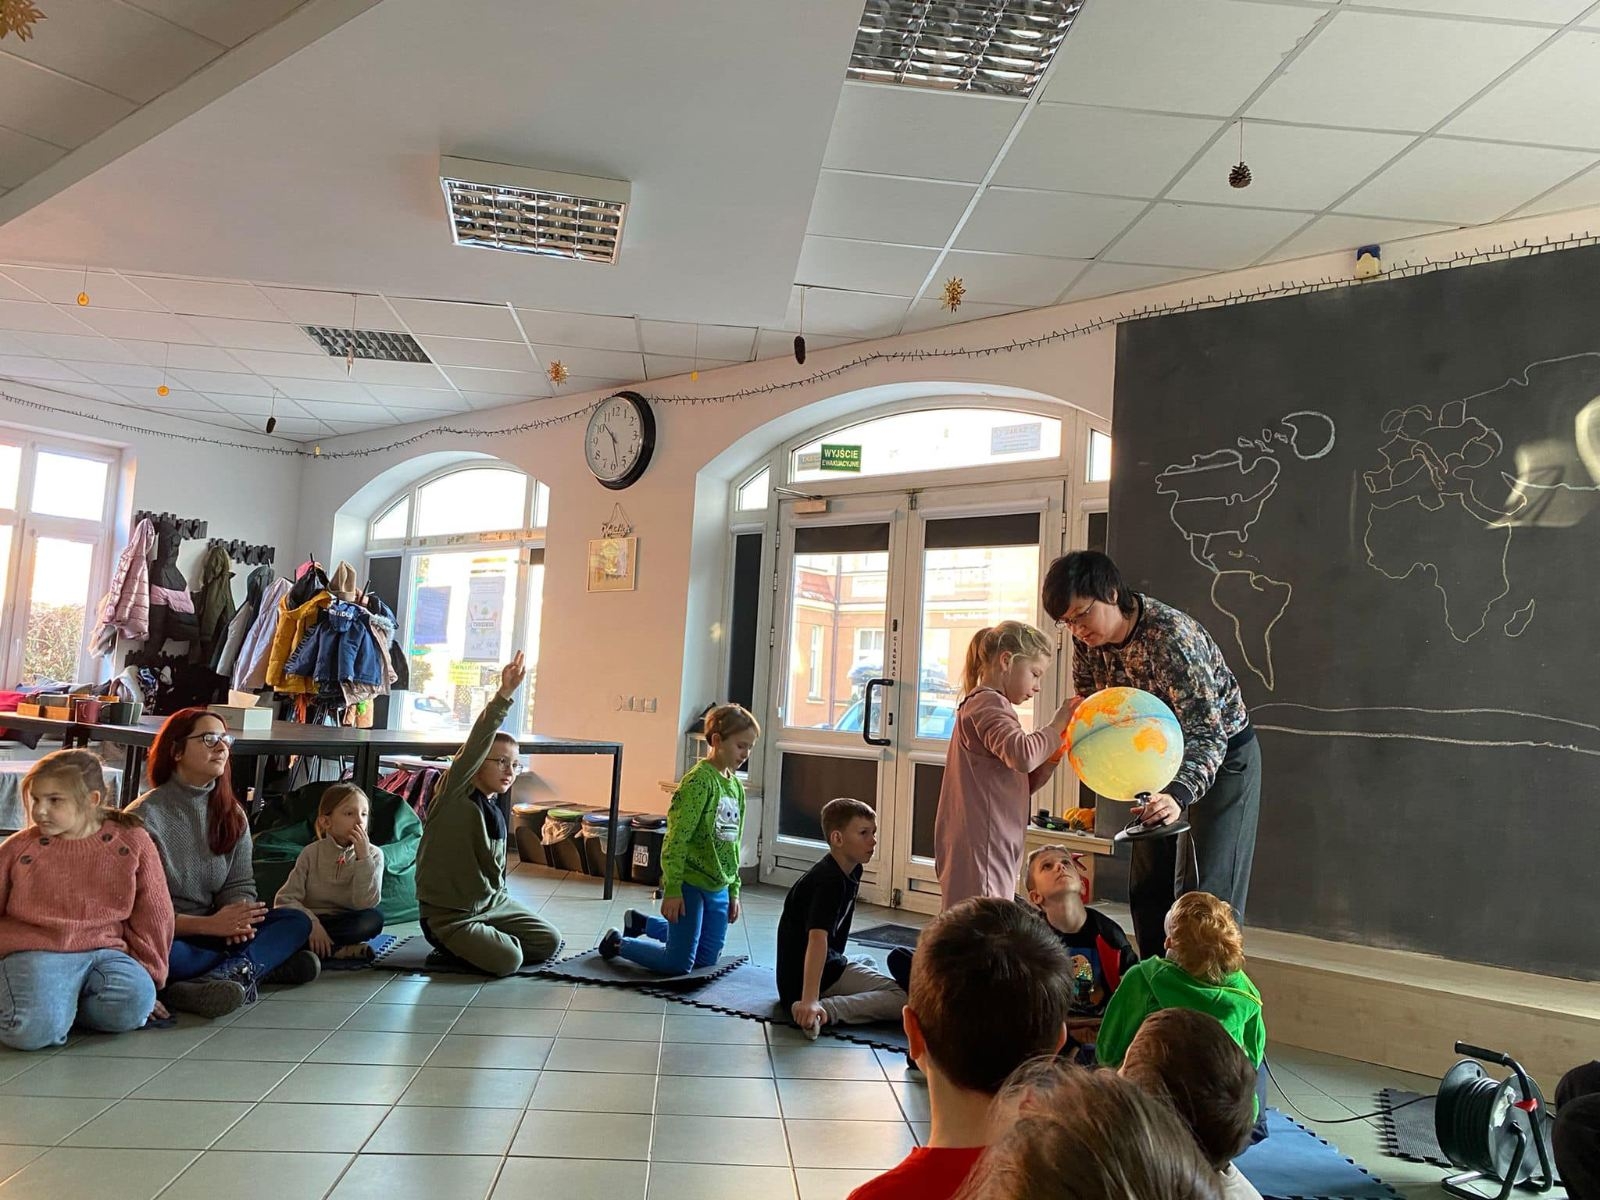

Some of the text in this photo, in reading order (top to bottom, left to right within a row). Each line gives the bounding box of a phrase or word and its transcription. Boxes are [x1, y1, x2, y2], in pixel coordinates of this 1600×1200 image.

[604, 410, 610, 422] 11
[612, 406, 620, 416] 12
[595, 423, 605, 433] 10
[632, 430, 638, 440] 3
[593, 437, 599, 447] 9
[594, 449, 601, 460] 8
[824, 448, 859, 458] WYJŚCIE
[602, 458, 607, 468] 7
[621, 455, 627, 468] 5
[634, 852, 648, 864] BIO
